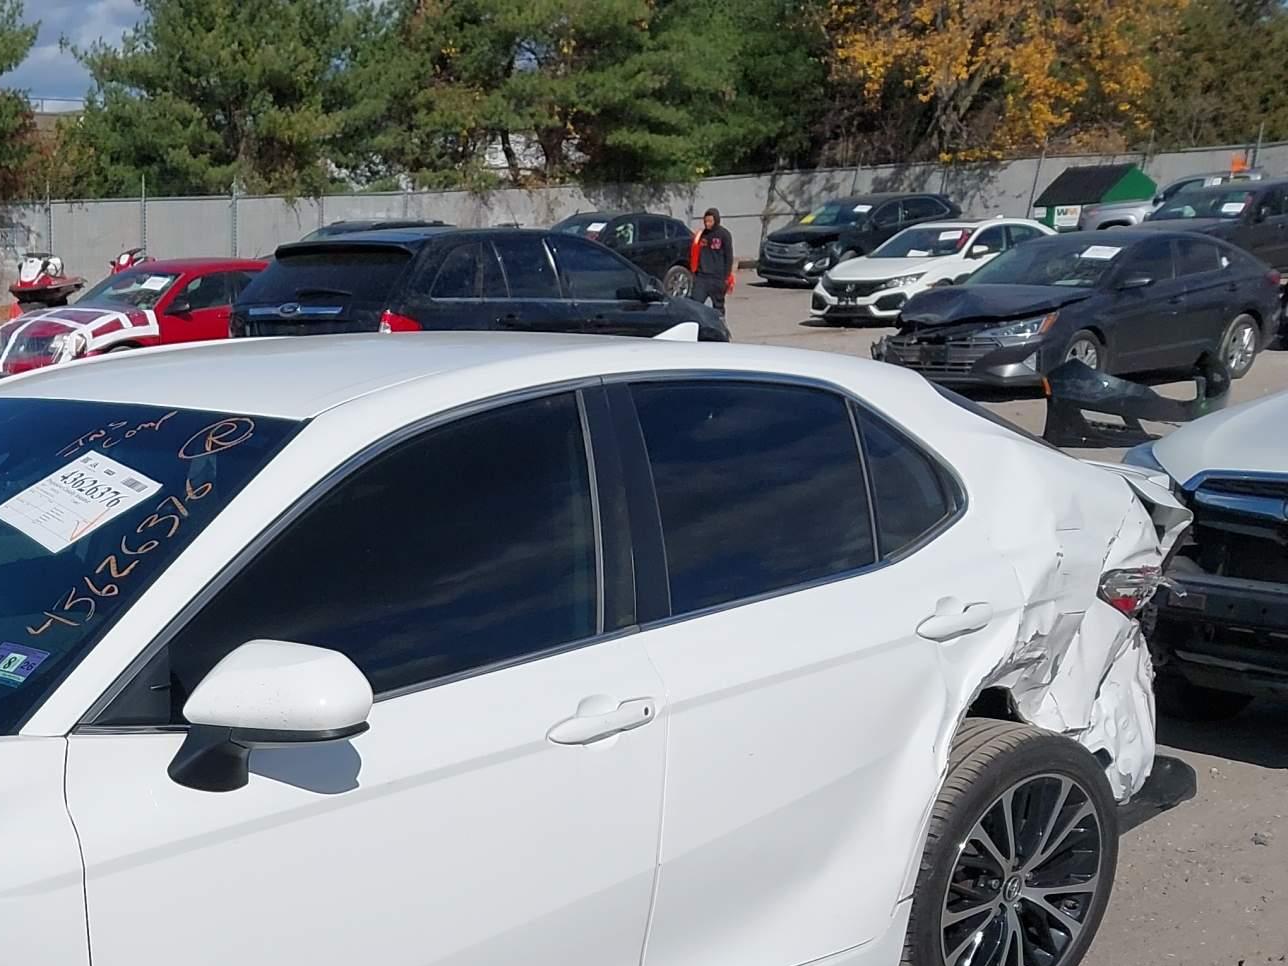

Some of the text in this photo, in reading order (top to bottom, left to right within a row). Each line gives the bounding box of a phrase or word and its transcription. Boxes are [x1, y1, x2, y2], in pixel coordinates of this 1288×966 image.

[60, 470, 129, 508] 43626376
[2, 656, 18, 670] 8
[20, 660, 37, 672] 26
